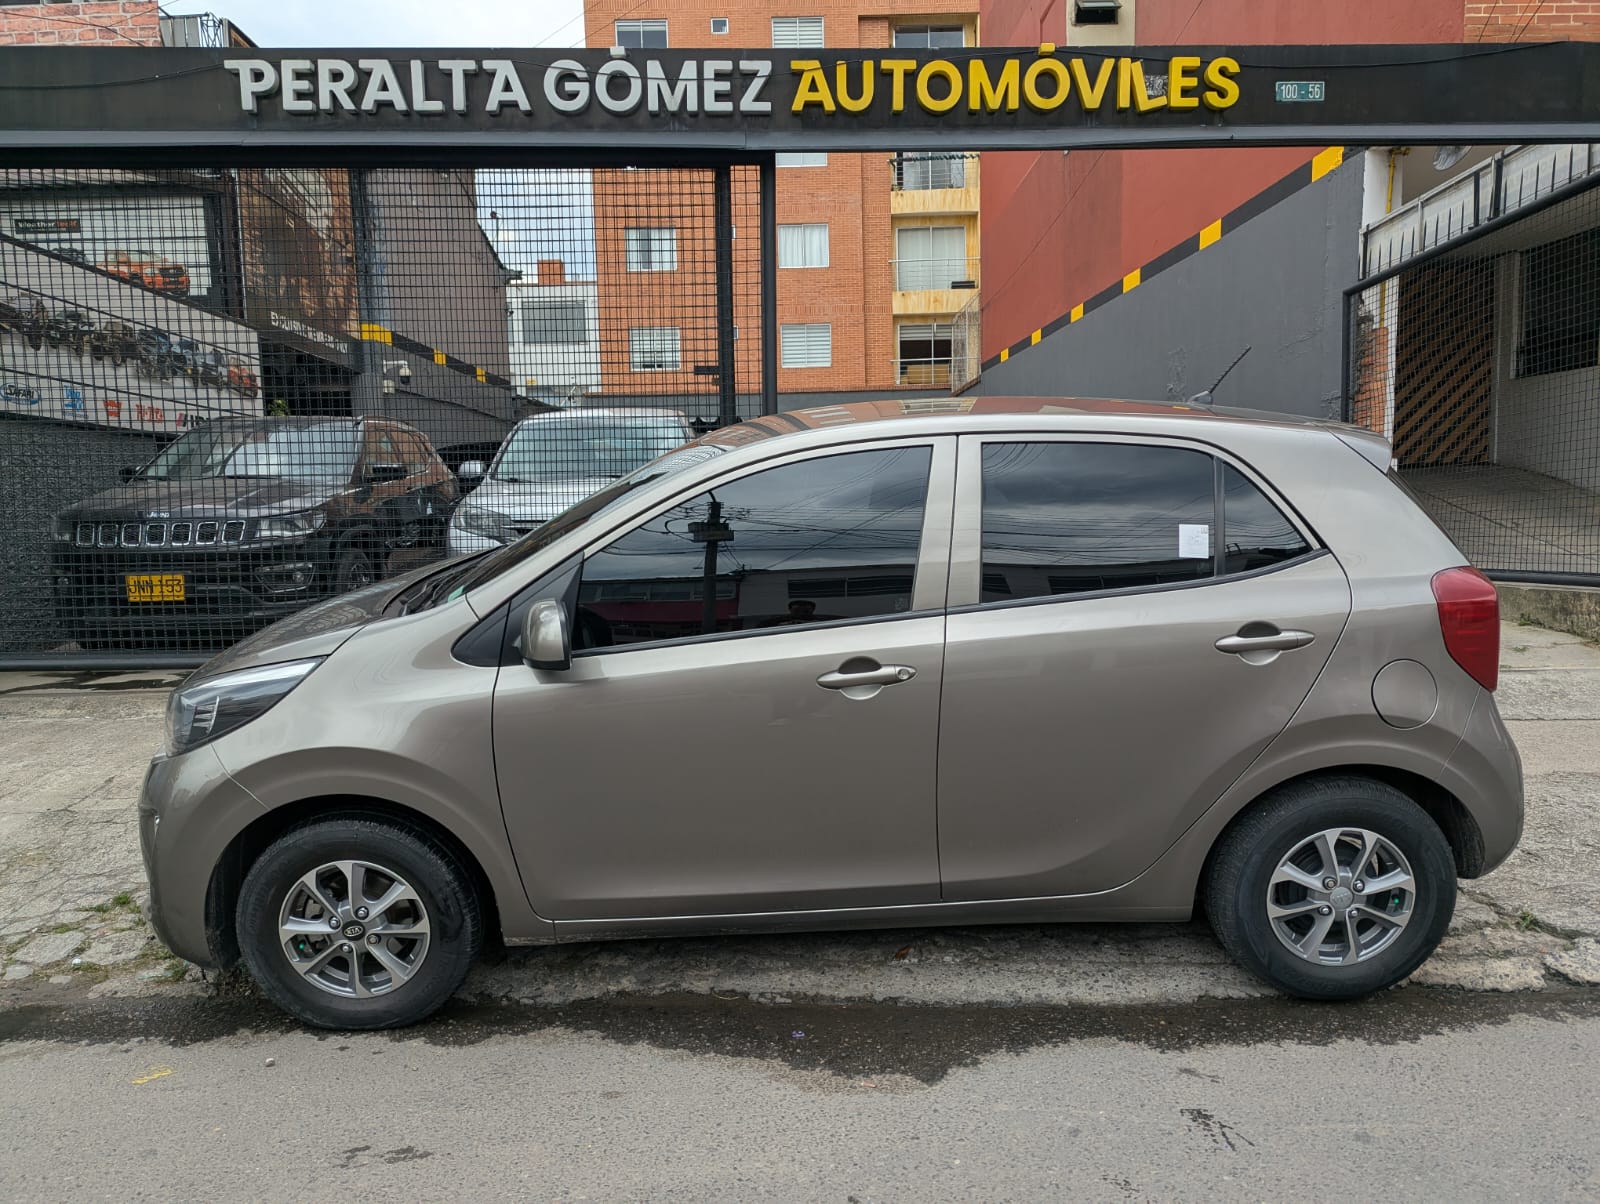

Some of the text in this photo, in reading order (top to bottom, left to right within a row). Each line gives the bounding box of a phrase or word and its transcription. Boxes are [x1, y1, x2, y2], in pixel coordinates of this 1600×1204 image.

[223, 42, 1242, 115] PERALTA GÓMEZ AUTOMÓVILES
[1280, 84, 1298, 99] 100
[1308, 84, 1321, 99] 56
